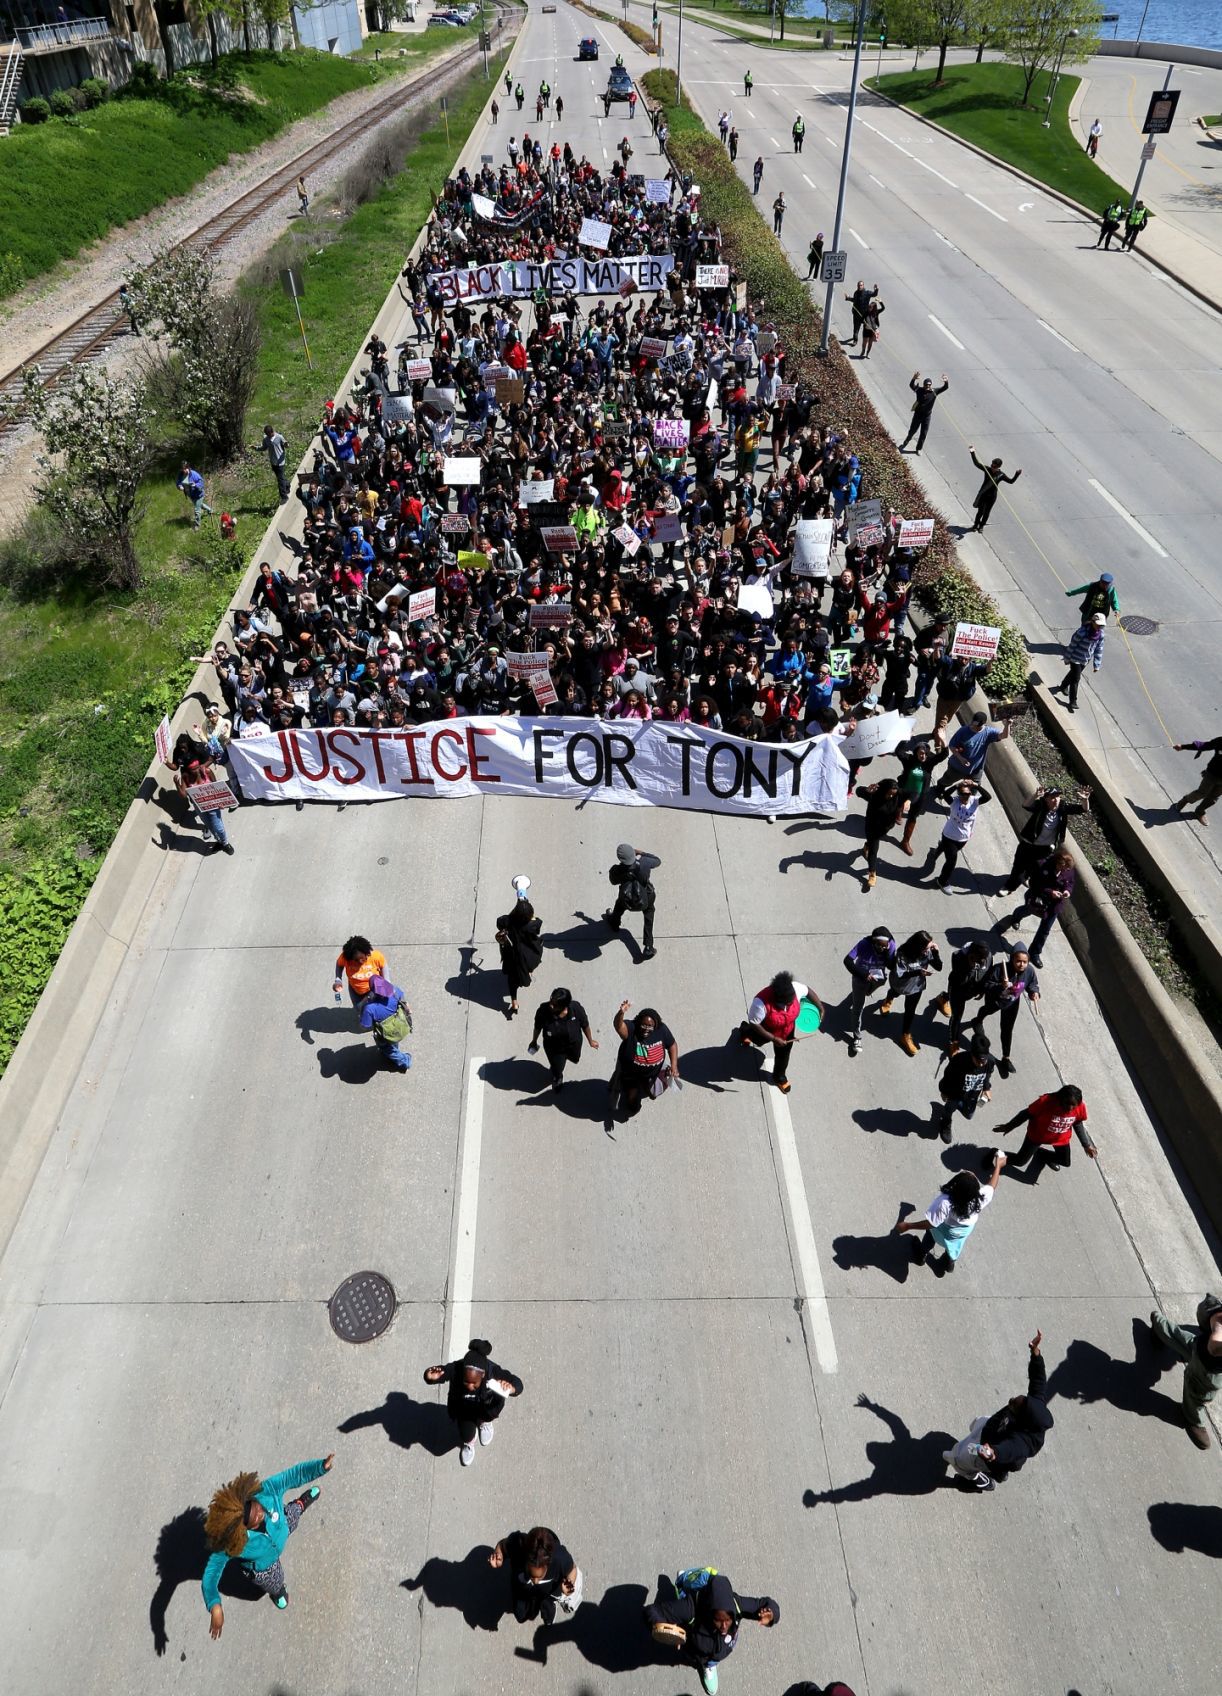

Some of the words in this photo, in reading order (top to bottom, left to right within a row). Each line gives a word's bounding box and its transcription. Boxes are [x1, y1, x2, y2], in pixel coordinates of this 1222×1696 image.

[824, 268, 843, 280] 35
[438, 267, 502, 300] BLACK
[512, 261, 577, 292] LIVES
[583, 260, 665, 290] MATTER
[654, 436, 689, 447] MATTER
[958, 631, 972, 639] The
[969, 626, 988, 635] Fuck
[263, 727, 501, 786] JUSTICE
[532, 729, 637, 790] FOR
[666, 734, 816, 800] TONY
